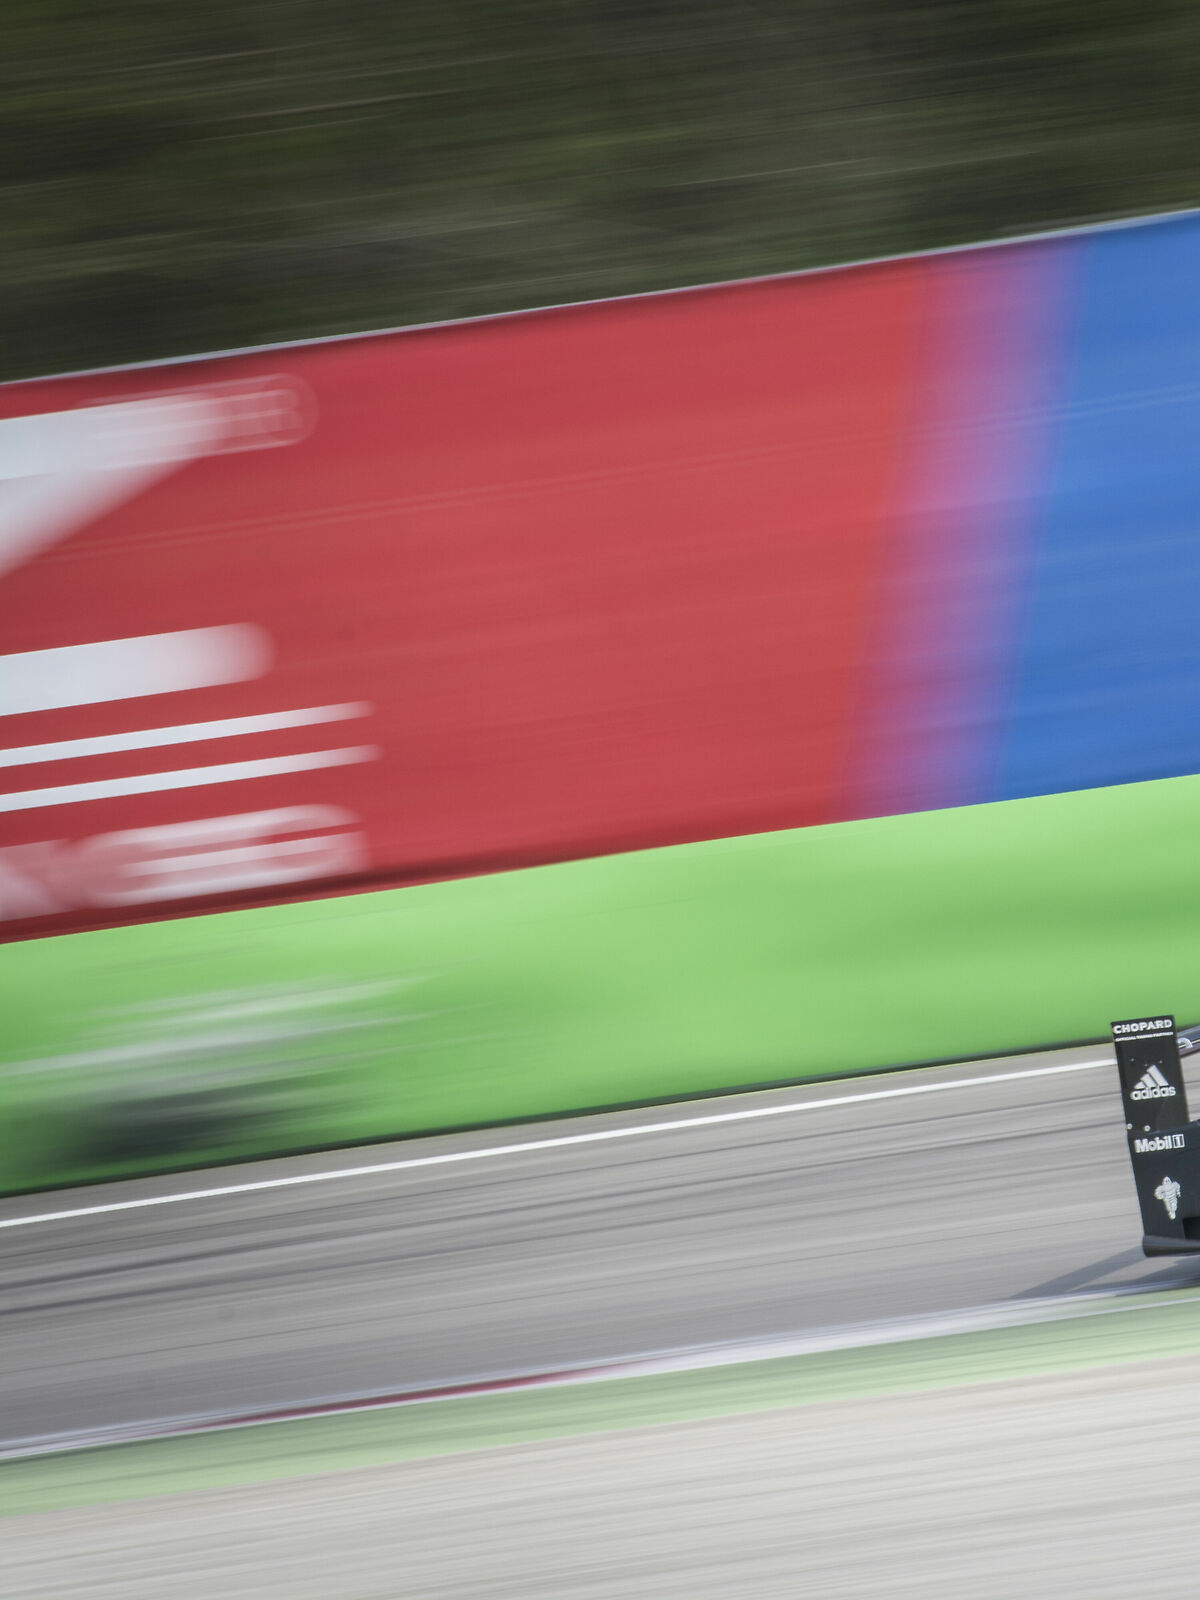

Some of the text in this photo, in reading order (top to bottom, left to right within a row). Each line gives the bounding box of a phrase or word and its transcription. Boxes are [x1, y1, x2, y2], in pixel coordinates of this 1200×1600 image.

[1113, 1019, 1173, 1035] CHOPARD
[1130, 1085, 1176, 1101] adidas
[1134, 1135, 1172, 1153] Mobil
